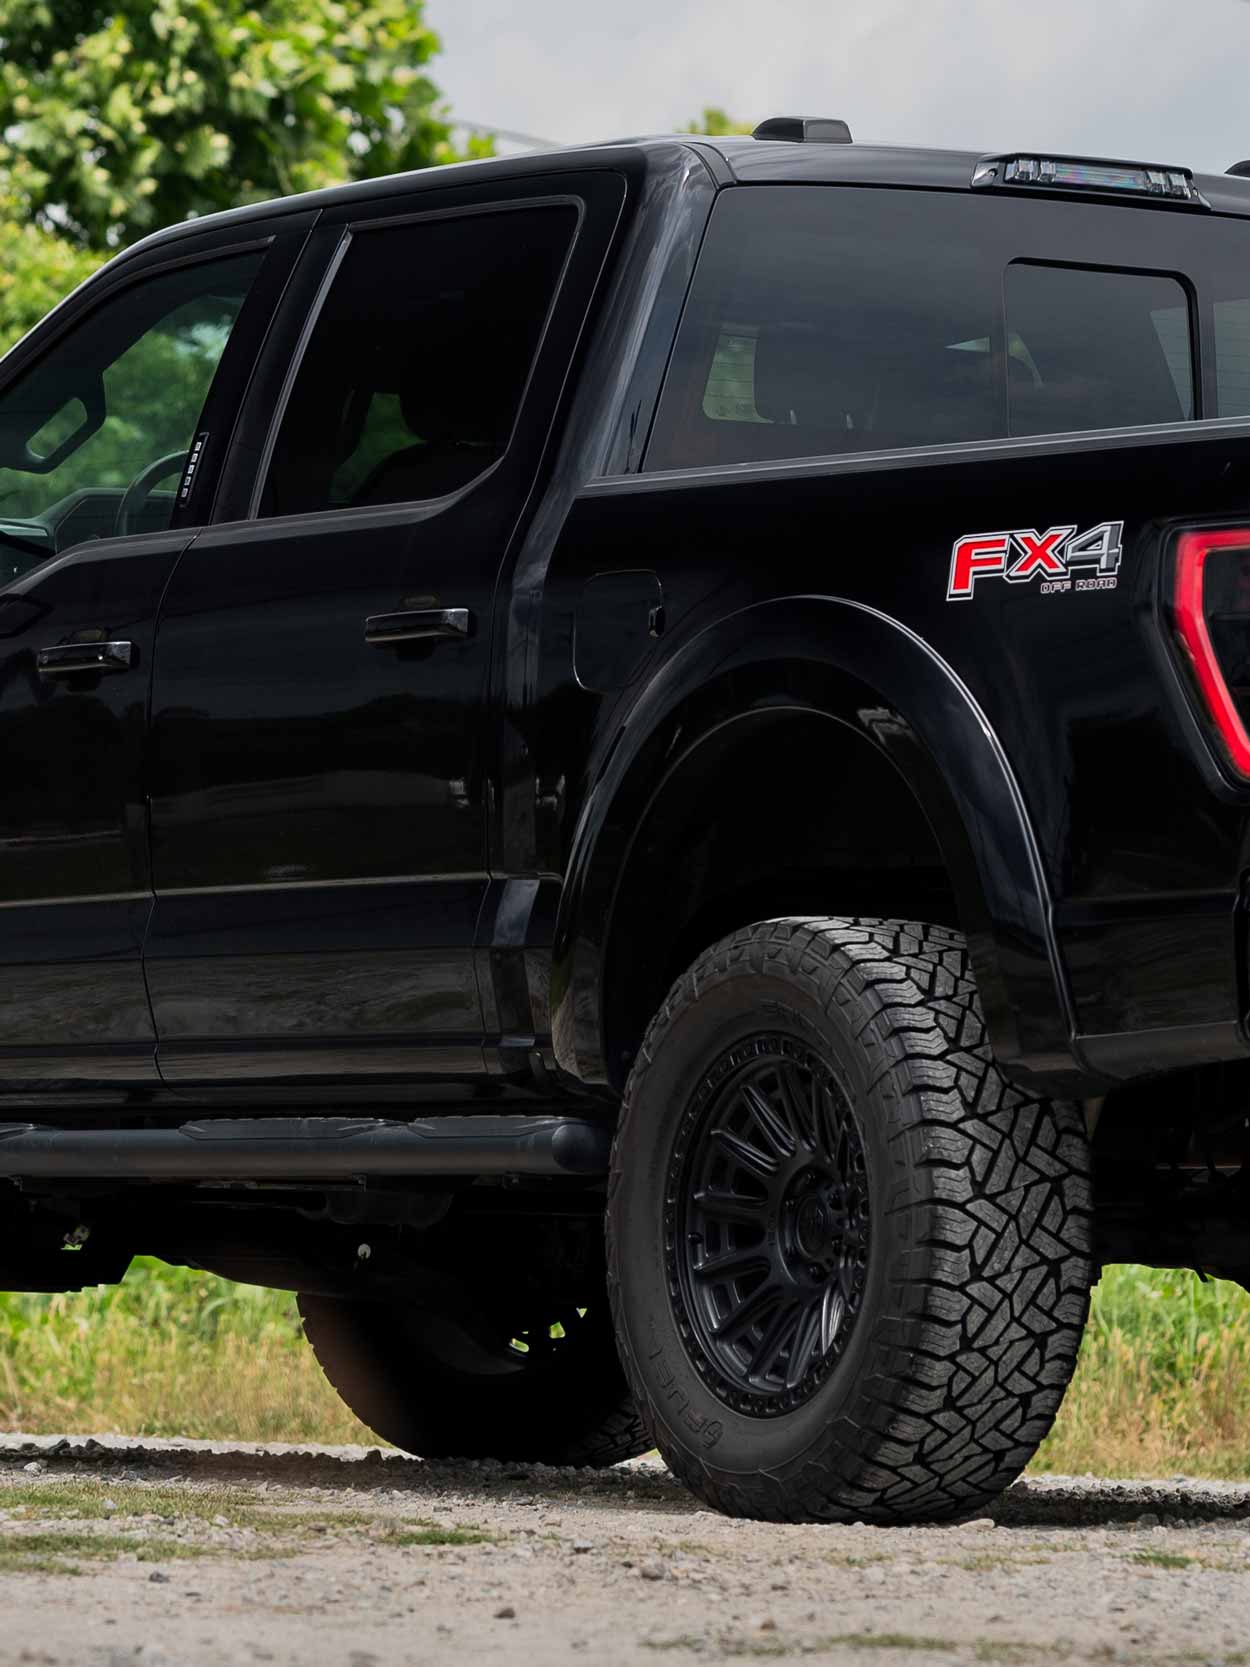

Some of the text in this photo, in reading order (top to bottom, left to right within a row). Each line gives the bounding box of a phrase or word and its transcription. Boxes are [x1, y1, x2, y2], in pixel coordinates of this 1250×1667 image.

[946, 520, 1124, 601] FX4
[1040, 577, 1117, 593] OFF ROAD
